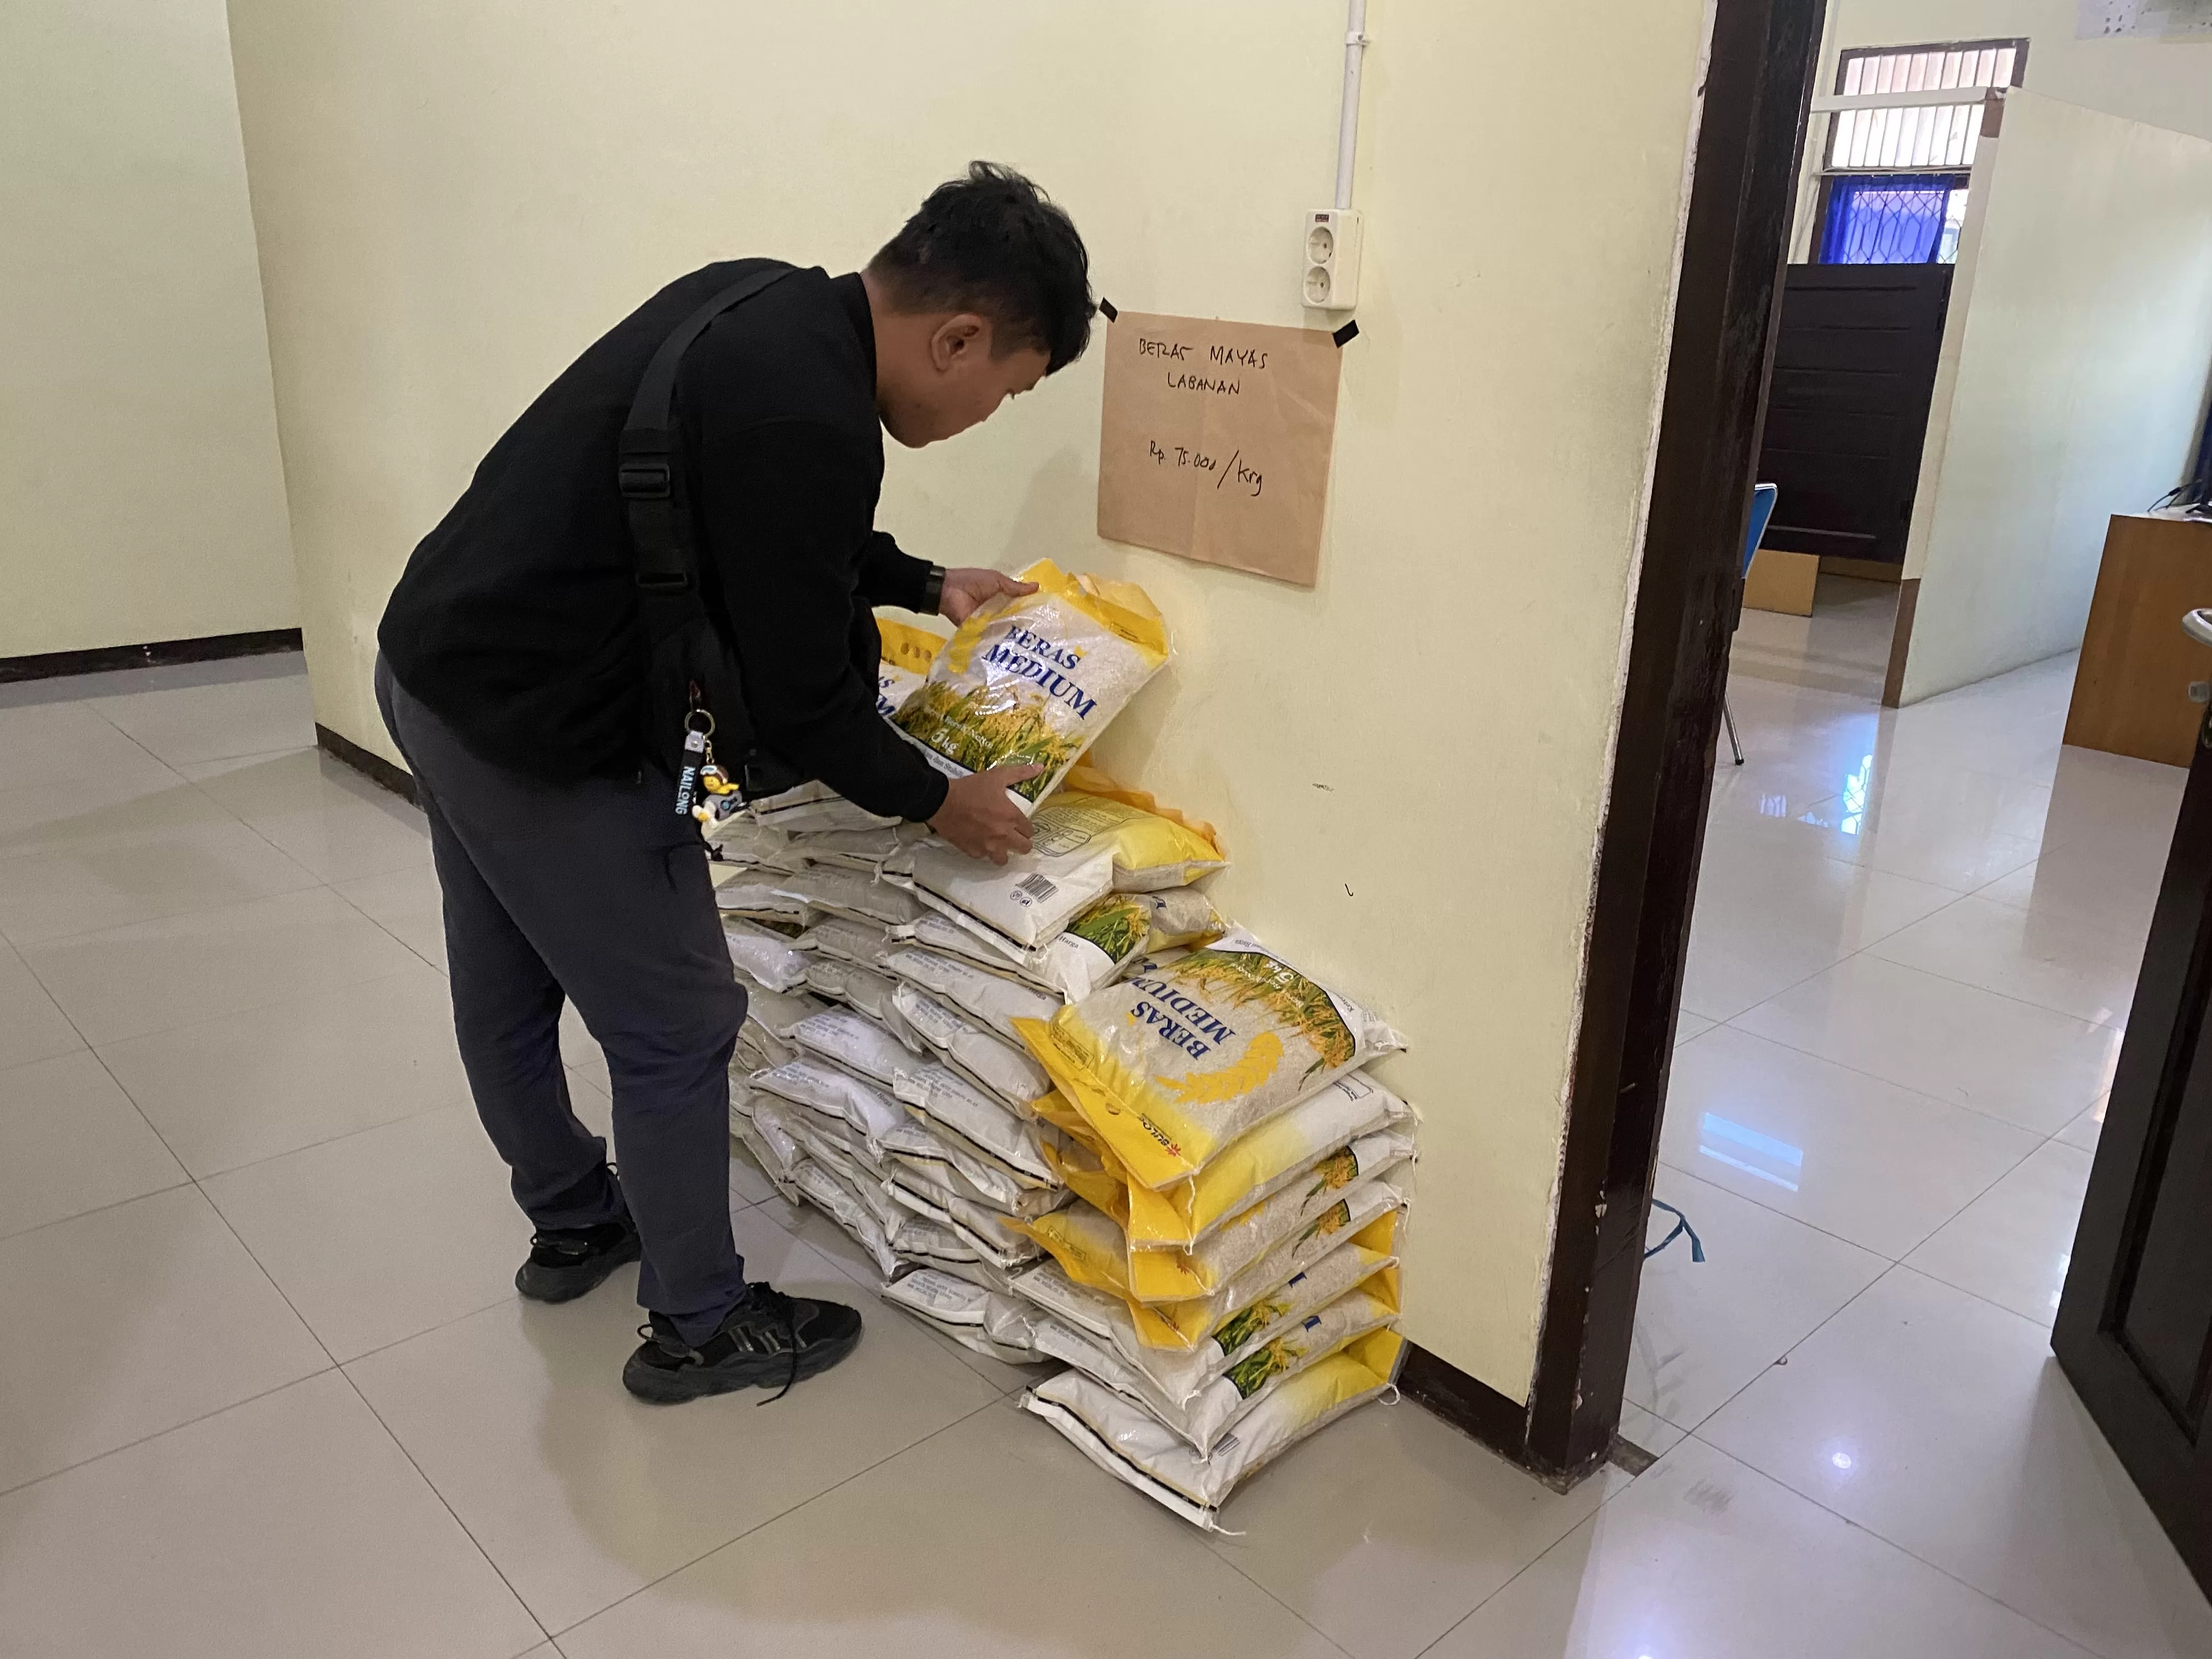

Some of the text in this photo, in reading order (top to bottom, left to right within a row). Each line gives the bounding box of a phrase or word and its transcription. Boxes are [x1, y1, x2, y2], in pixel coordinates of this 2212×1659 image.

[1210, 345, 1268, 369] MAYAS
[1167, 371, 1240, 395] LABANAN
[1003, 625, 1082, 670] BERAS
[981, 644, 1097, 721] MEDIUM
[930, 728, 959, 755] 5 kg
[674, 766, 696, 815] NAILONG
[1058, 934, 1079, 949] Harga
[1263, 959, 1283, 975] kg
[1273, 970, 1295, 986] 5
[1130, 1000, 1211, 1060] BERAS
